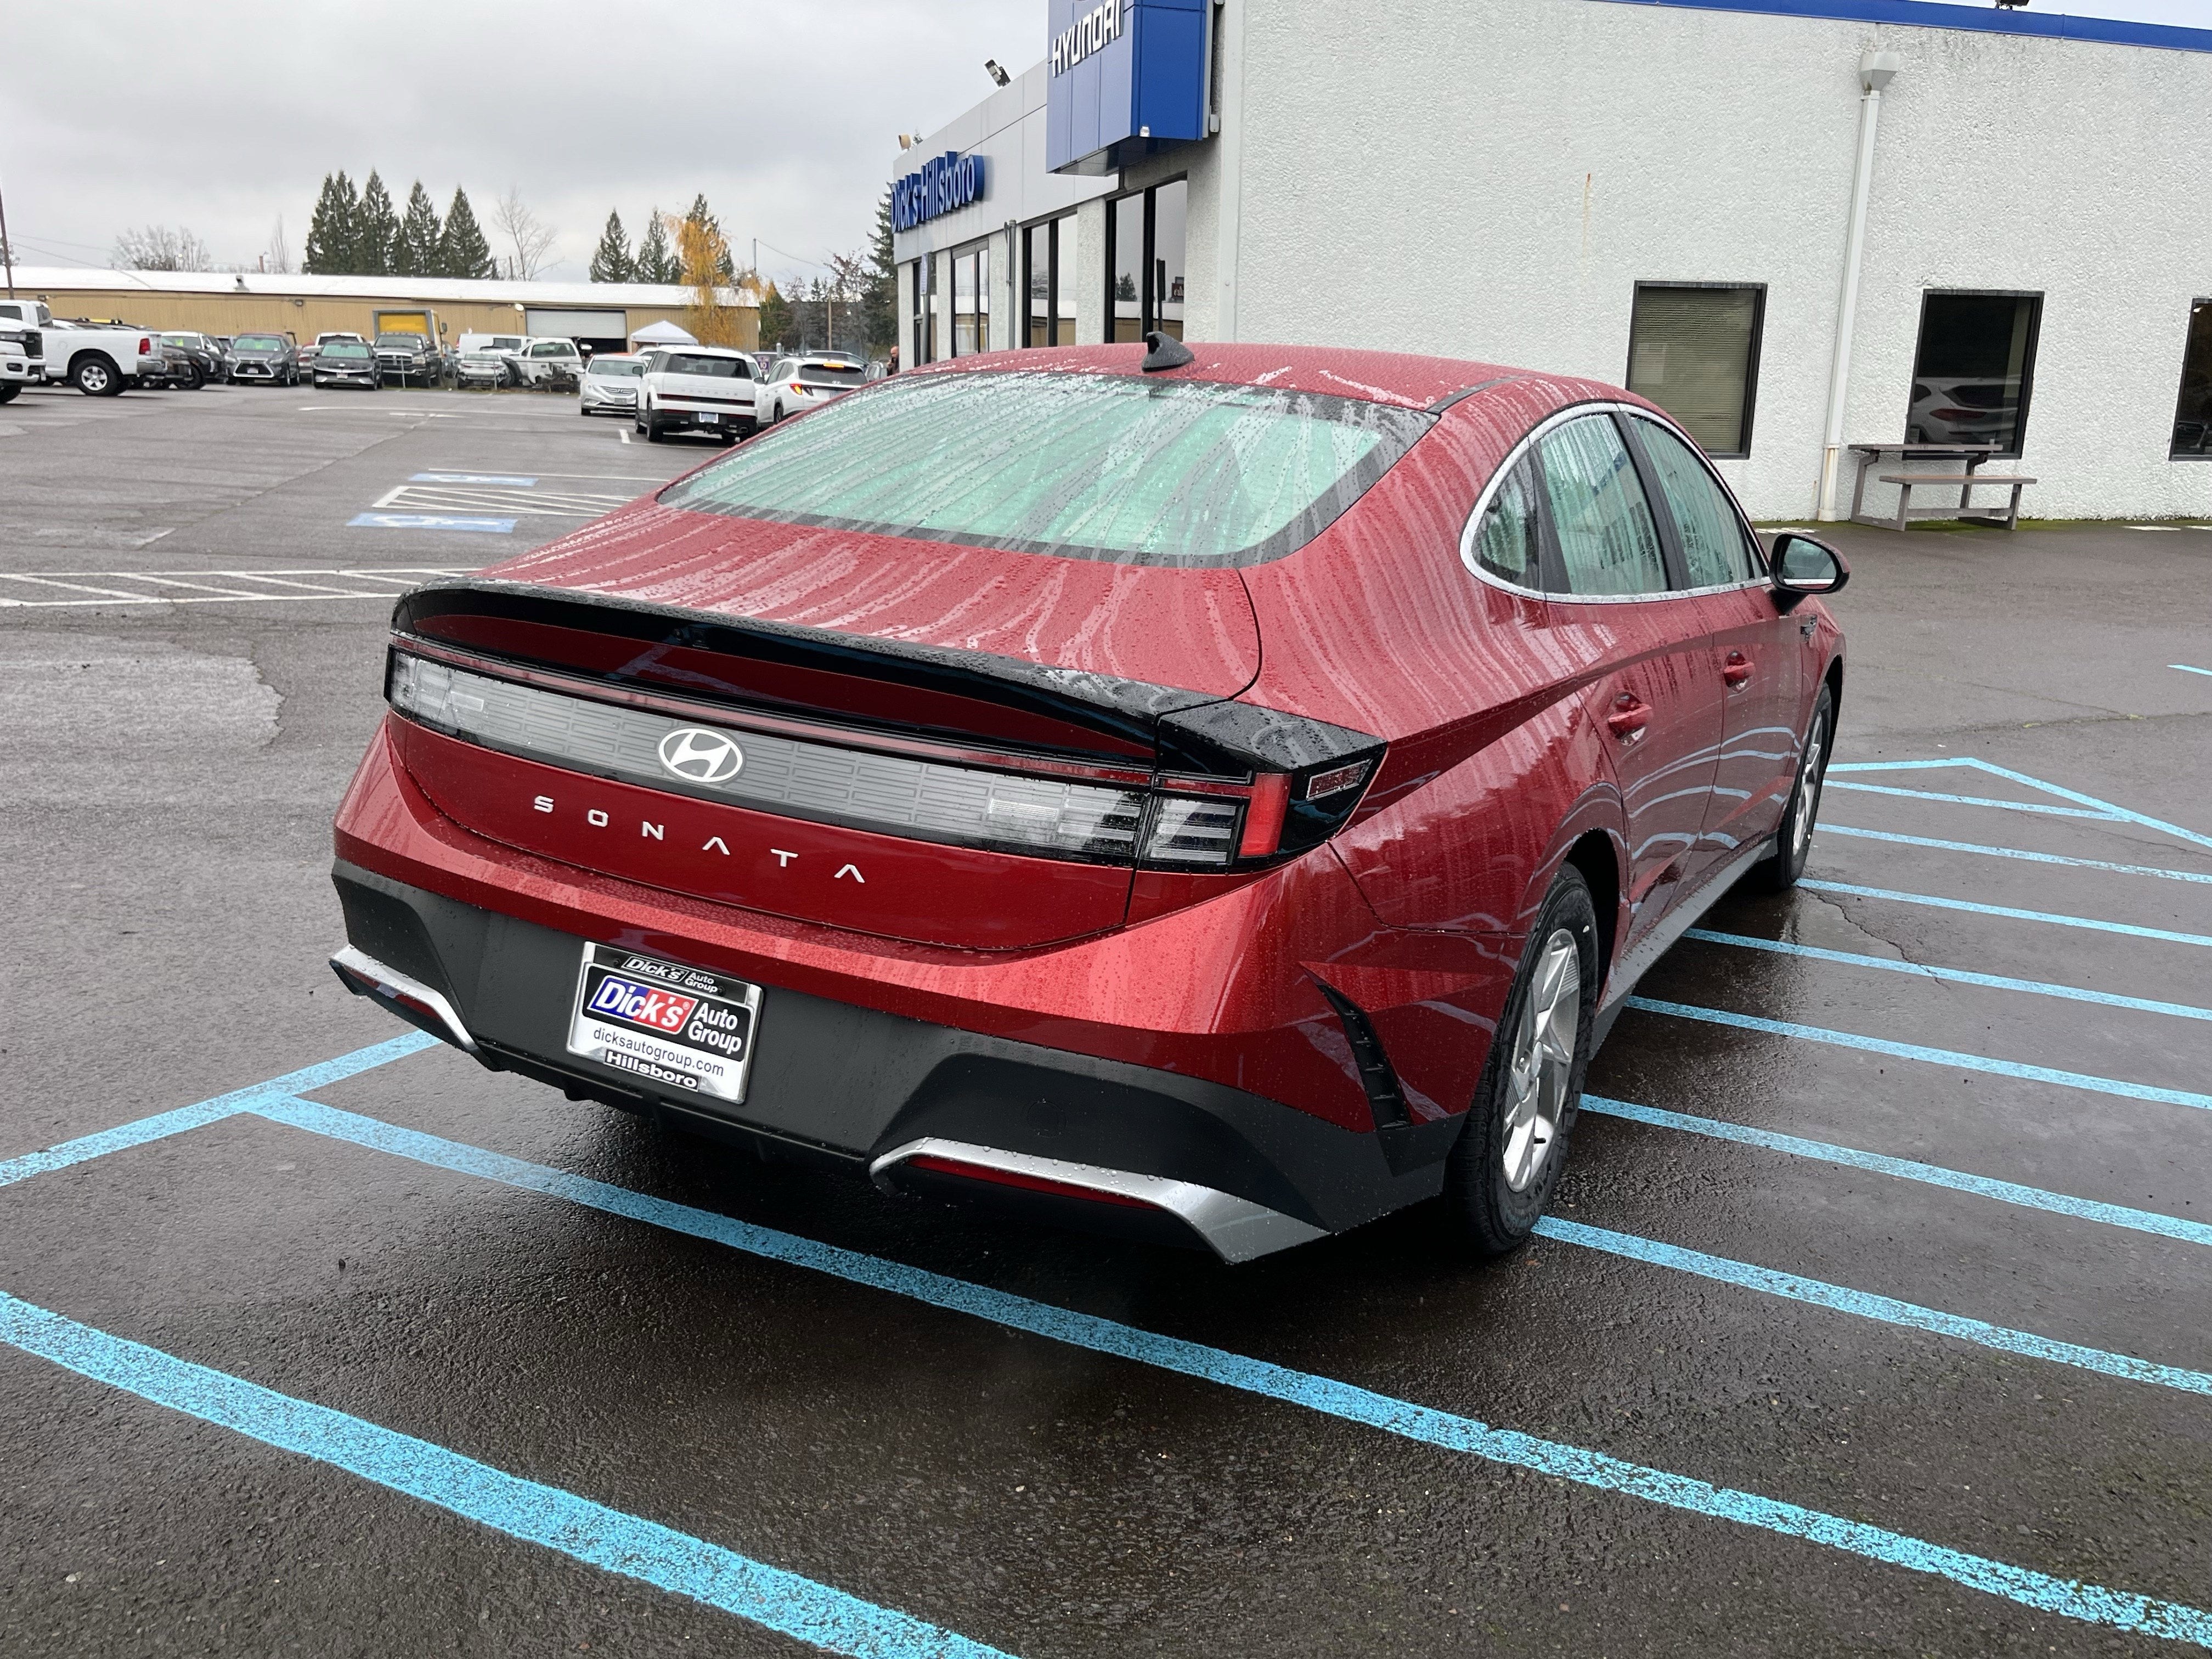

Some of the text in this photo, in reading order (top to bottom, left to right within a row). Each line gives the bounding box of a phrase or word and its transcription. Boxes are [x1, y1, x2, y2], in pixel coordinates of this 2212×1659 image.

[1053, 0, 1120, 77] HYUNDAI
[922, 151, 975, 221] Hillsboro
[534, 795, 865, 884] SONATA
[626, 958, 715, 985] Dick's Auto
[685, 978, 718, 994] Group
[595, 981, 738, 1030] Dick's Auto
[593, 1027, 724, 1077] dicksautogroup.com
[688, 1021, 742, 1055] Group
[606, 1051, 697, 1088] Hillsboro
